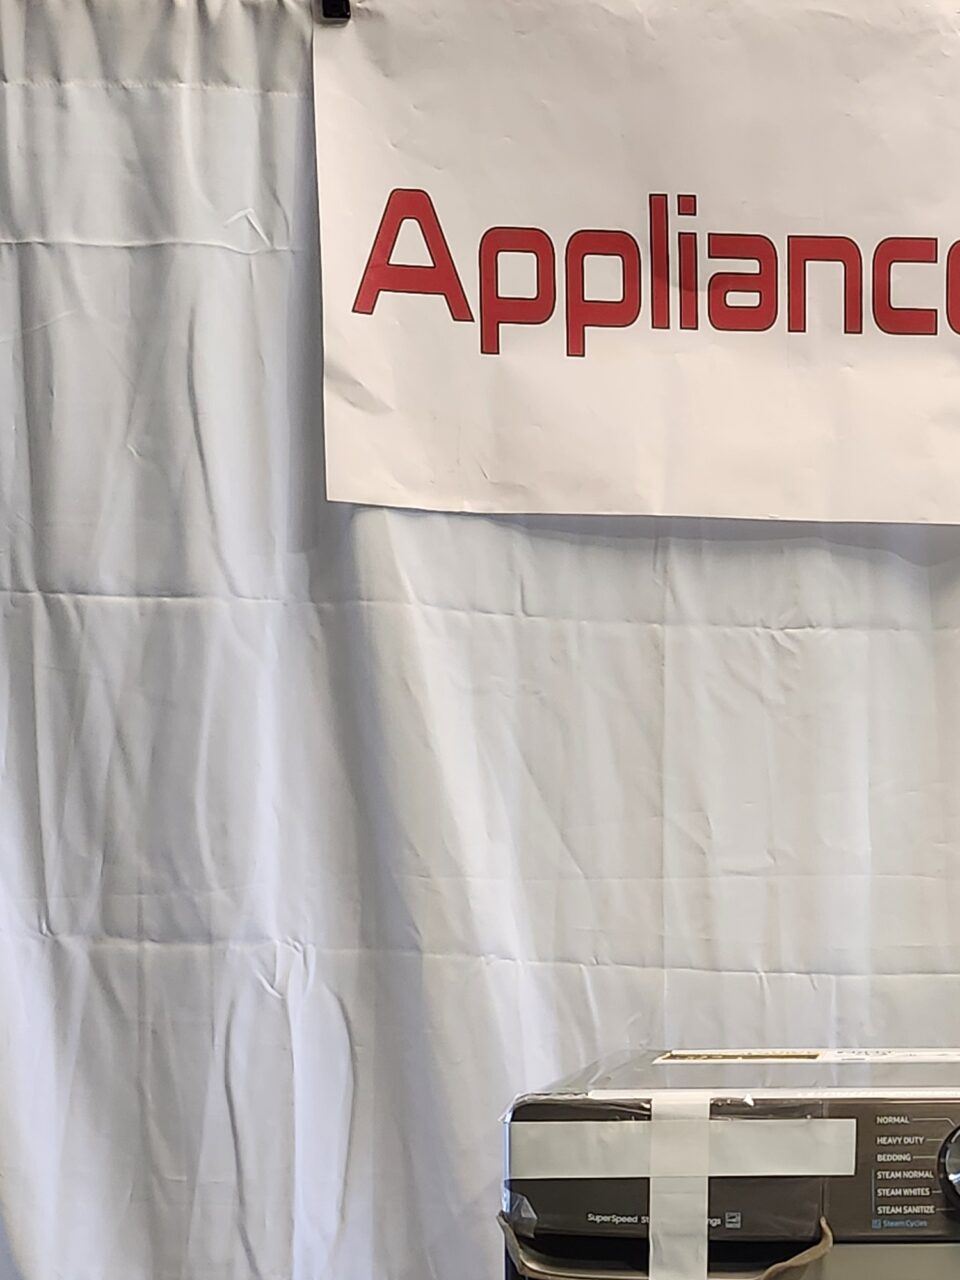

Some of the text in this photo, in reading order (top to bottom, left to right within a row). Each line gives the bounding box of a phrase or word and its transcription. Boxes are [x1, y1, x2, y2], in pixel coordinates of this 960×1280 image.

[876, 1116, 910, 1124] NORMAL
[876, 1154, 911, 1162] BEDDING
[877, 1170, 934, 1179] STEAM NORMAL
[877, 1188, 930, 1196] STEAM WHITES
[877, 1206, 935, 1214] STEAM SANITIZE
